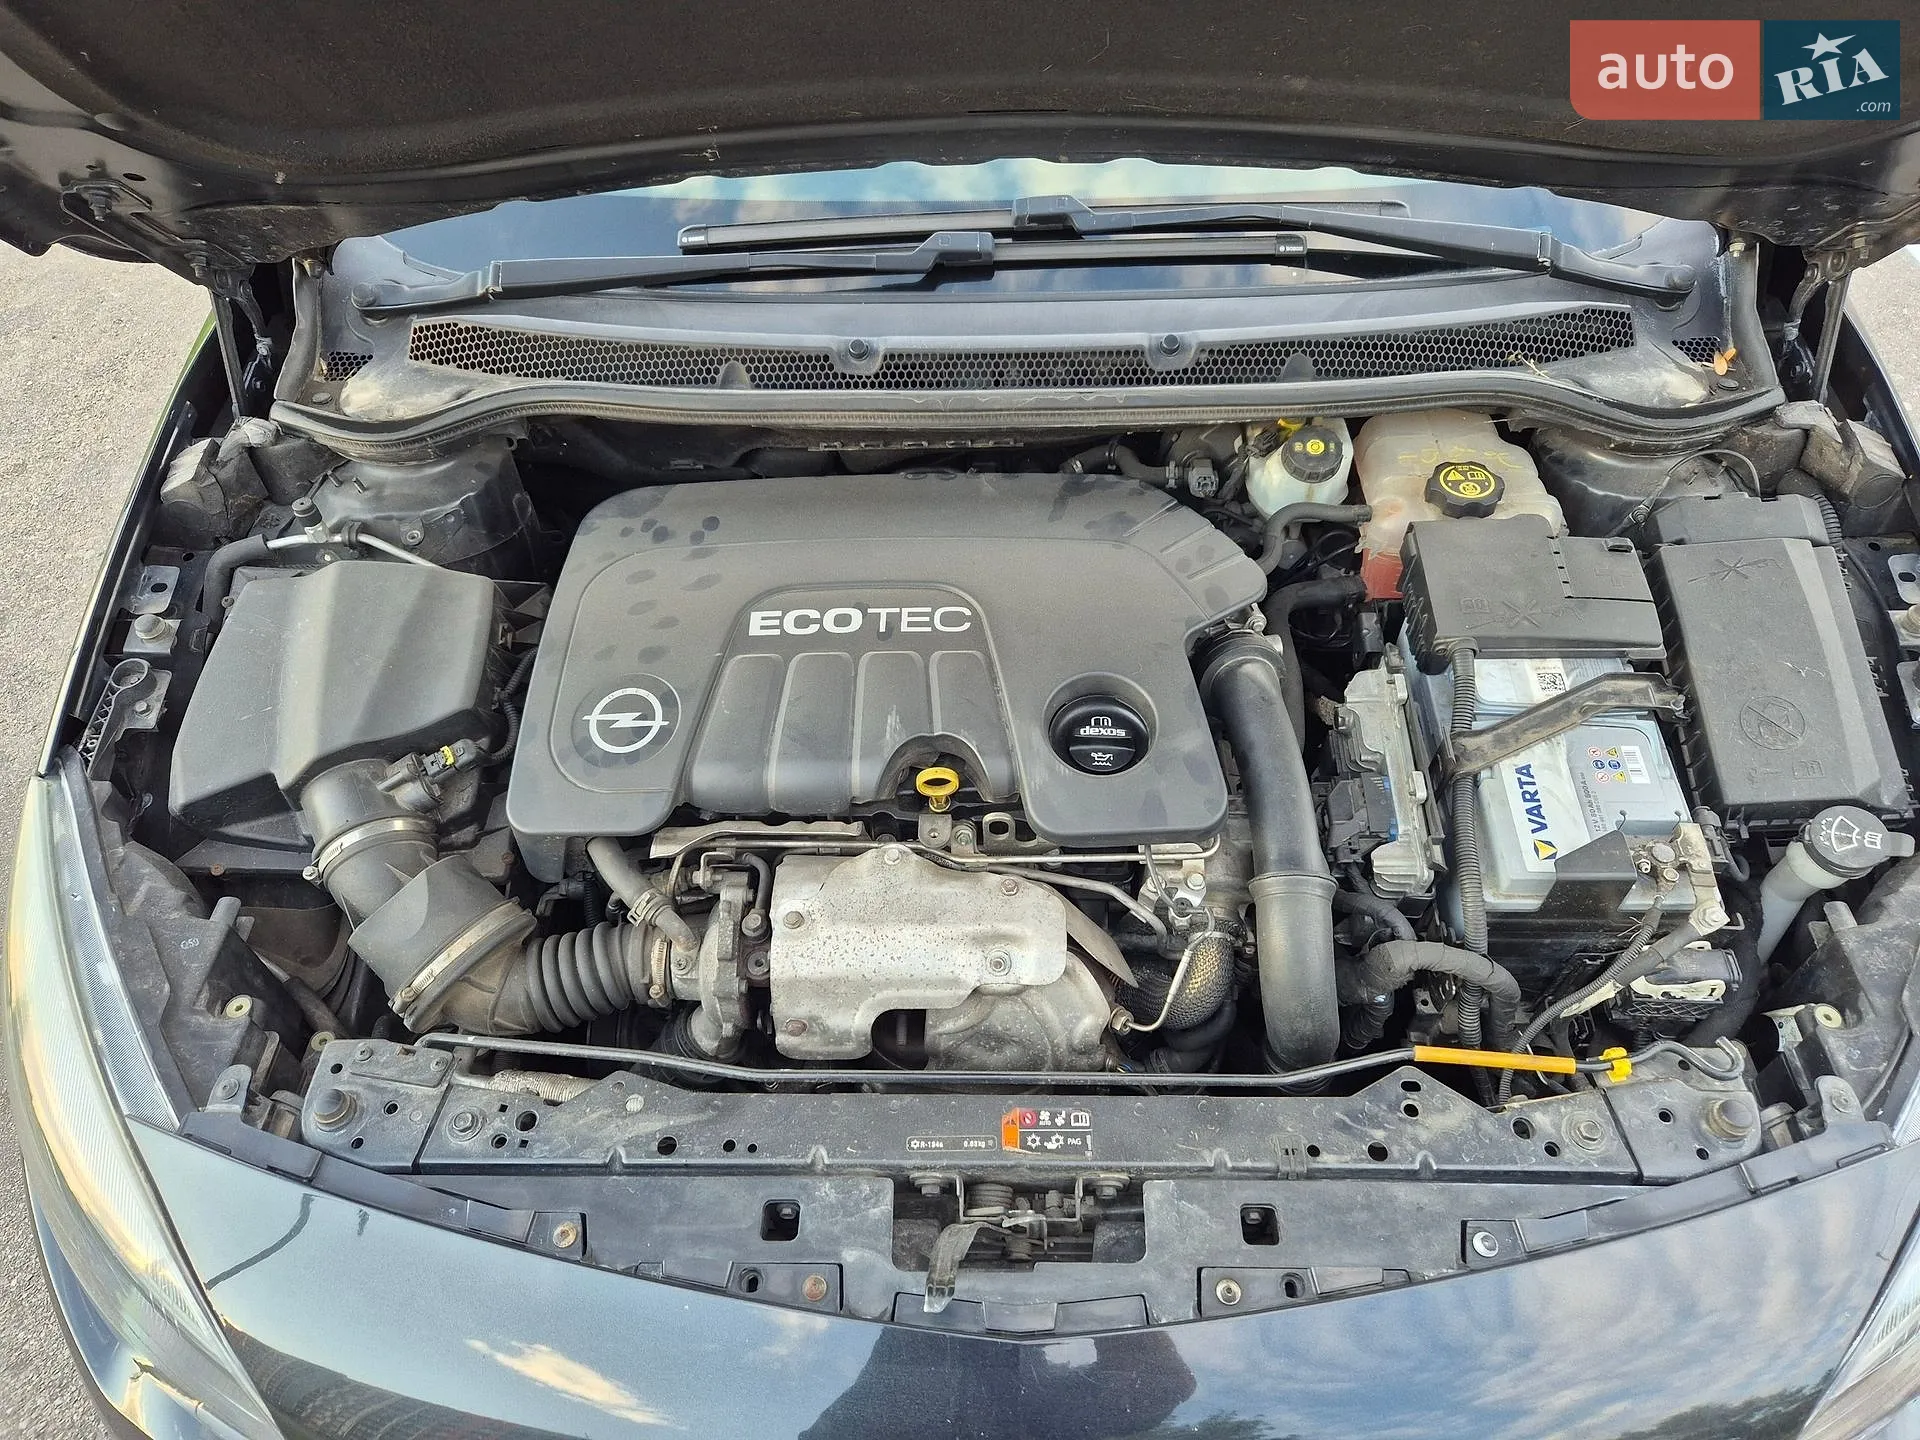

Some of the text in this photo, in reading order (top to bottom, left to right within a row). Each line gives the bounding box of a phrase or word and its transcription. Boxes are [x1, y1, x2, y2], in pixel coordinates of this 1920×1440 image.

[748, 606, 972, 636] ECOTEC
[1080, 725, 1127, 736] dexos
[1515, 763, 1548, 834] VARTA
[1067, 1137, 1082, 1145] PAG
